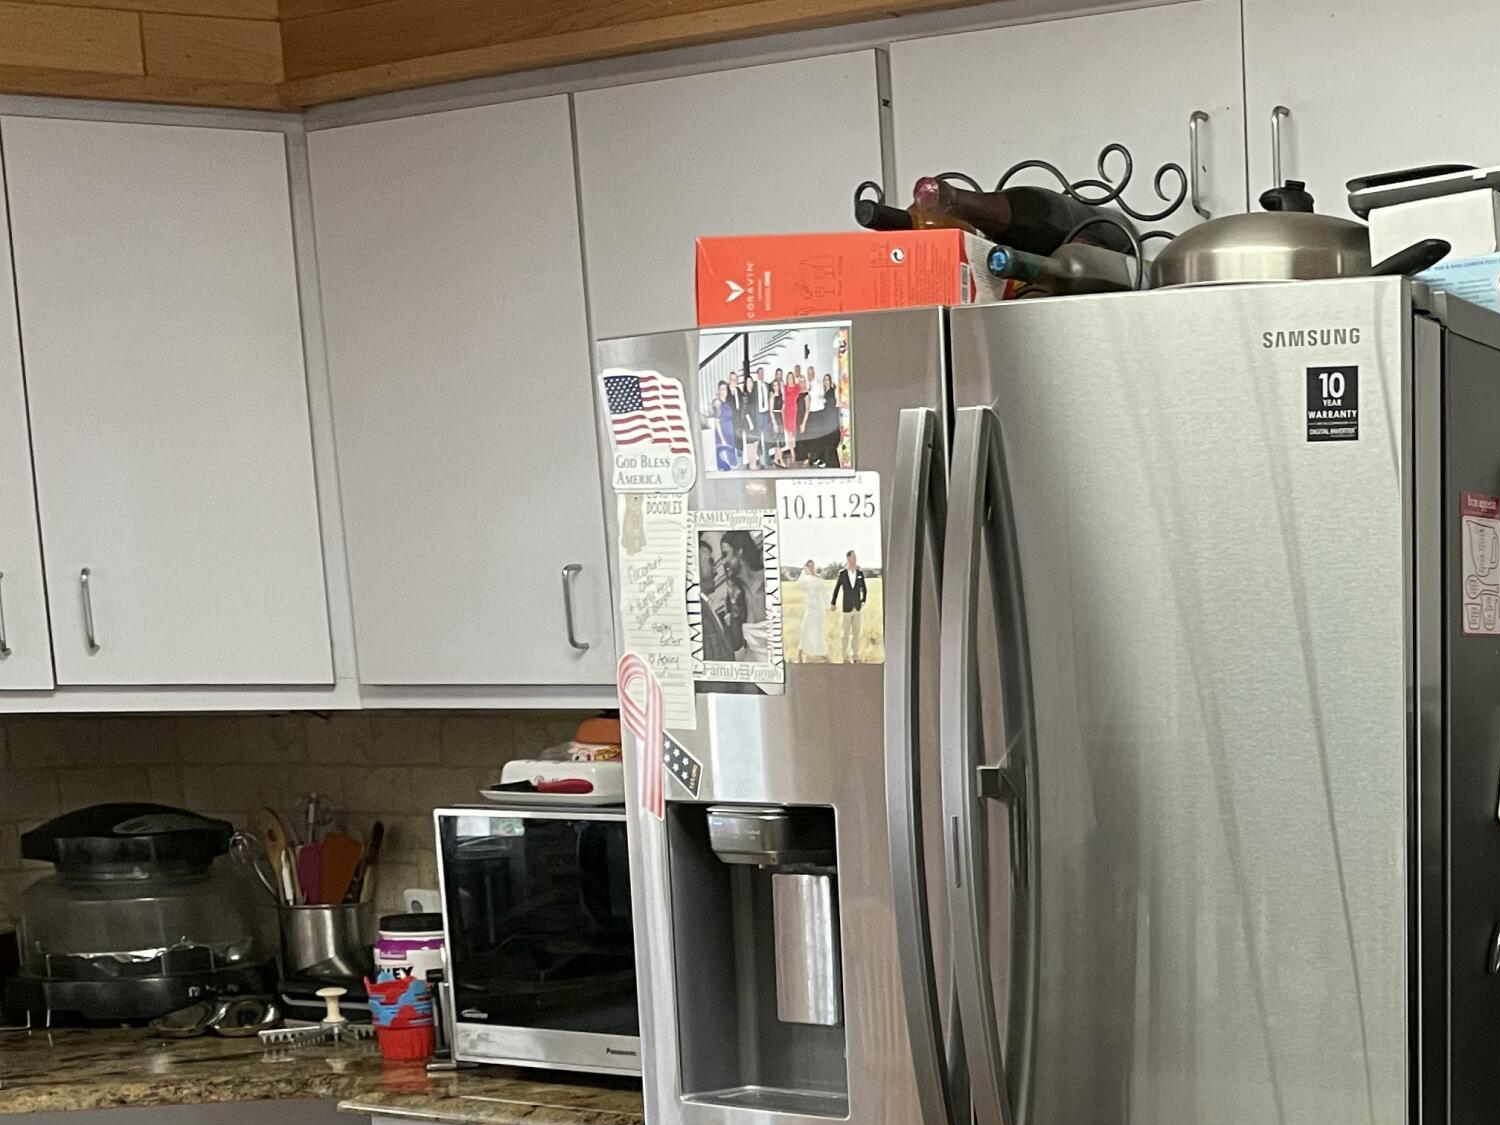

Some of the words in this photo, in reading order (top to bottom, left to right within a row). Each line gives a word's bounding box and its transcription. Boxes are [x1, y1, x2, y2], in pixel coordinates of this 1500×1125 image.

[746, 261, 755, 318] CORAVIN
[1262, 328, 1361, 348] SAMSUNG
[1319, 372, 1345, 399] 10
[1308, 410, 1357, 419] WARRANTY
[1322, 399, 1342, 407] YEAR
[783, 493, 875, 520] 10.11.25
[763, 513, 780, 600] FAMILY
